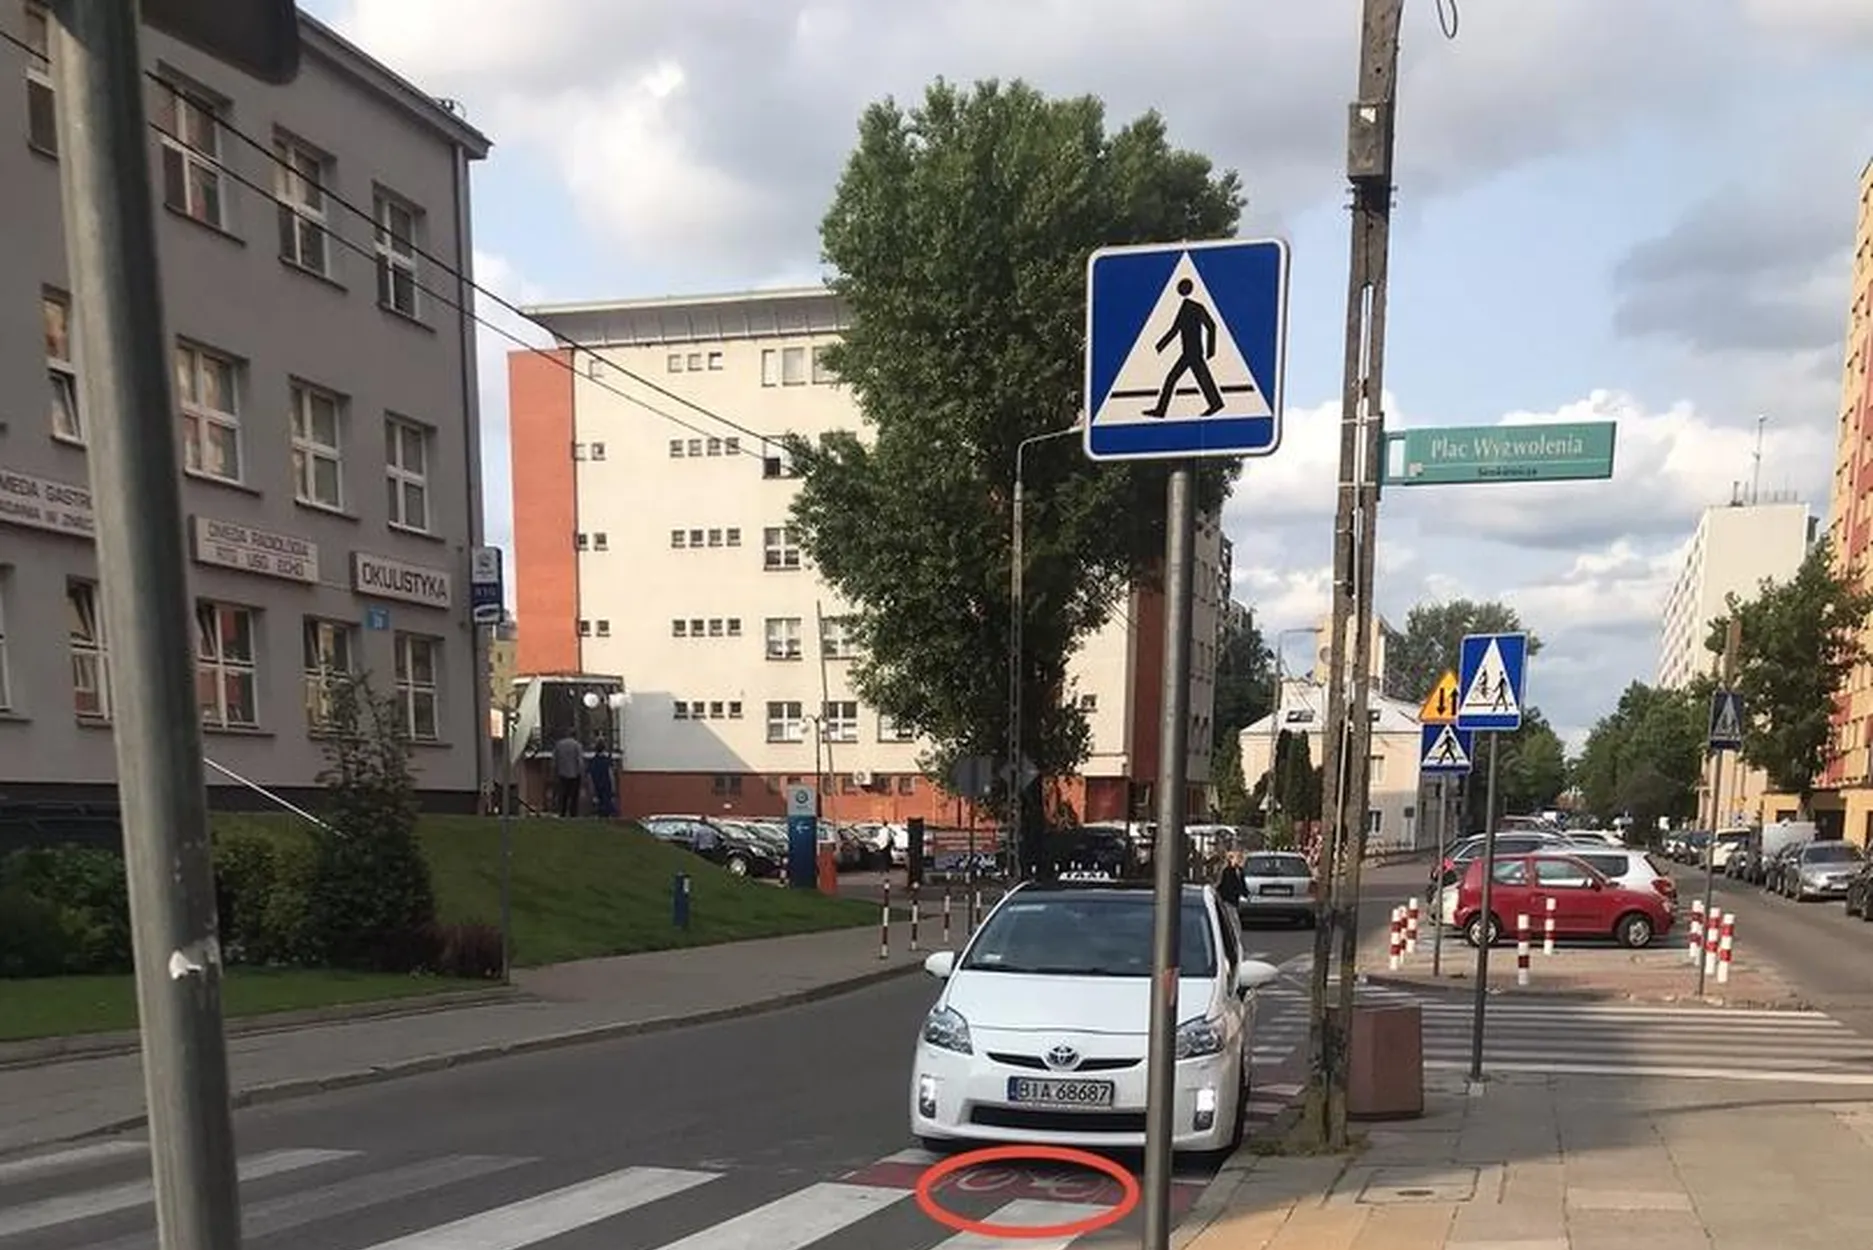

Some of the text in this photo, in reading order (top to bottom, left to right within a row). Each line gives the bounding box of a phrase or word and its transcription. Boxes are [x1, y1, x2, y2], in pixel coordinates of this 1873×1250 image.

[1431, 433, 1584, 460] Plac Wyzwolenia
[362, 562, 448, 599] OKULISTYKA
[1020, 1082, 1110, 1101] BIA 68687
